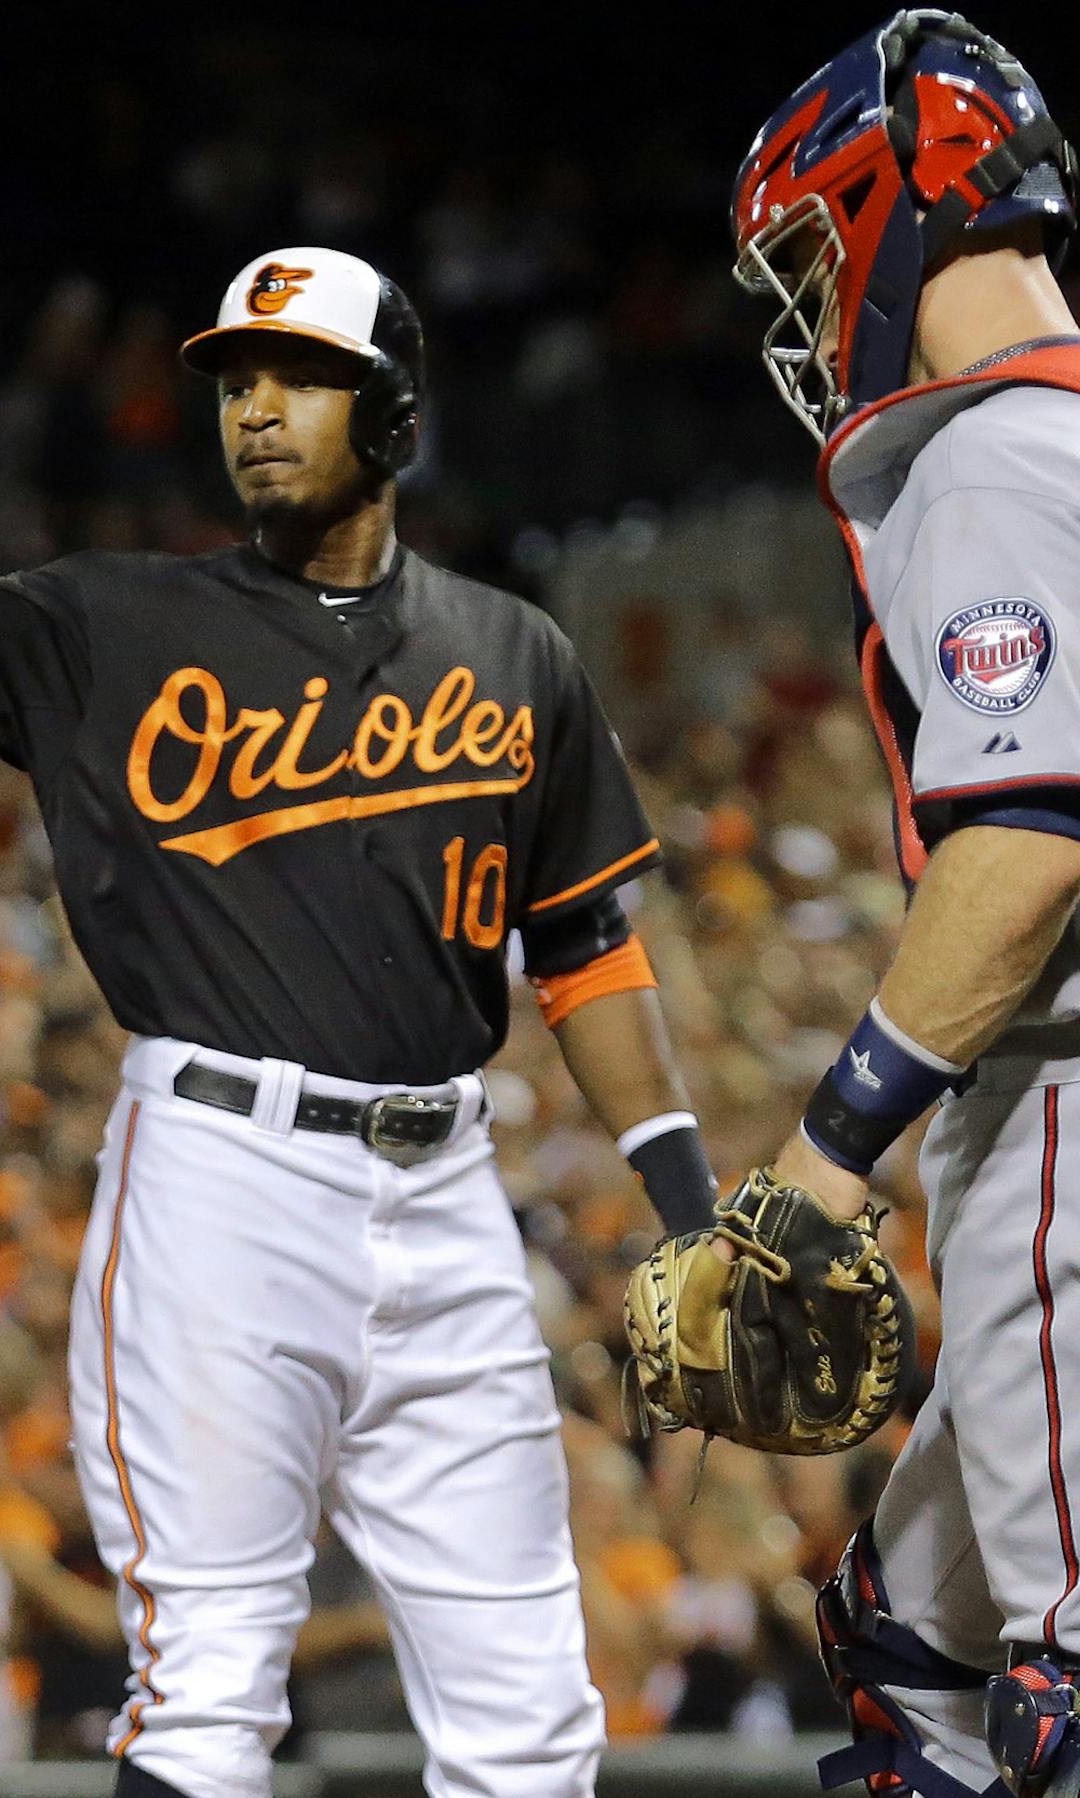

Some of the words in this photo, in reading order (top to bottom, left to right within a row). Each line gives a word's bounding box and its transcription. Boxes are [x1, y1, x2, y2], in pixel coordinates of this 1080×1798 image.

[951, 603, 1042, 633] MINNESOTA
[943, 626, 1046, 680] Twins
[953, 676, 1016, 708] BASEBALL
[1019, 671, 1042, 701] CLUB
[127, 666, 535, 824] Orioles
[441, 836, 508, 949] 10
